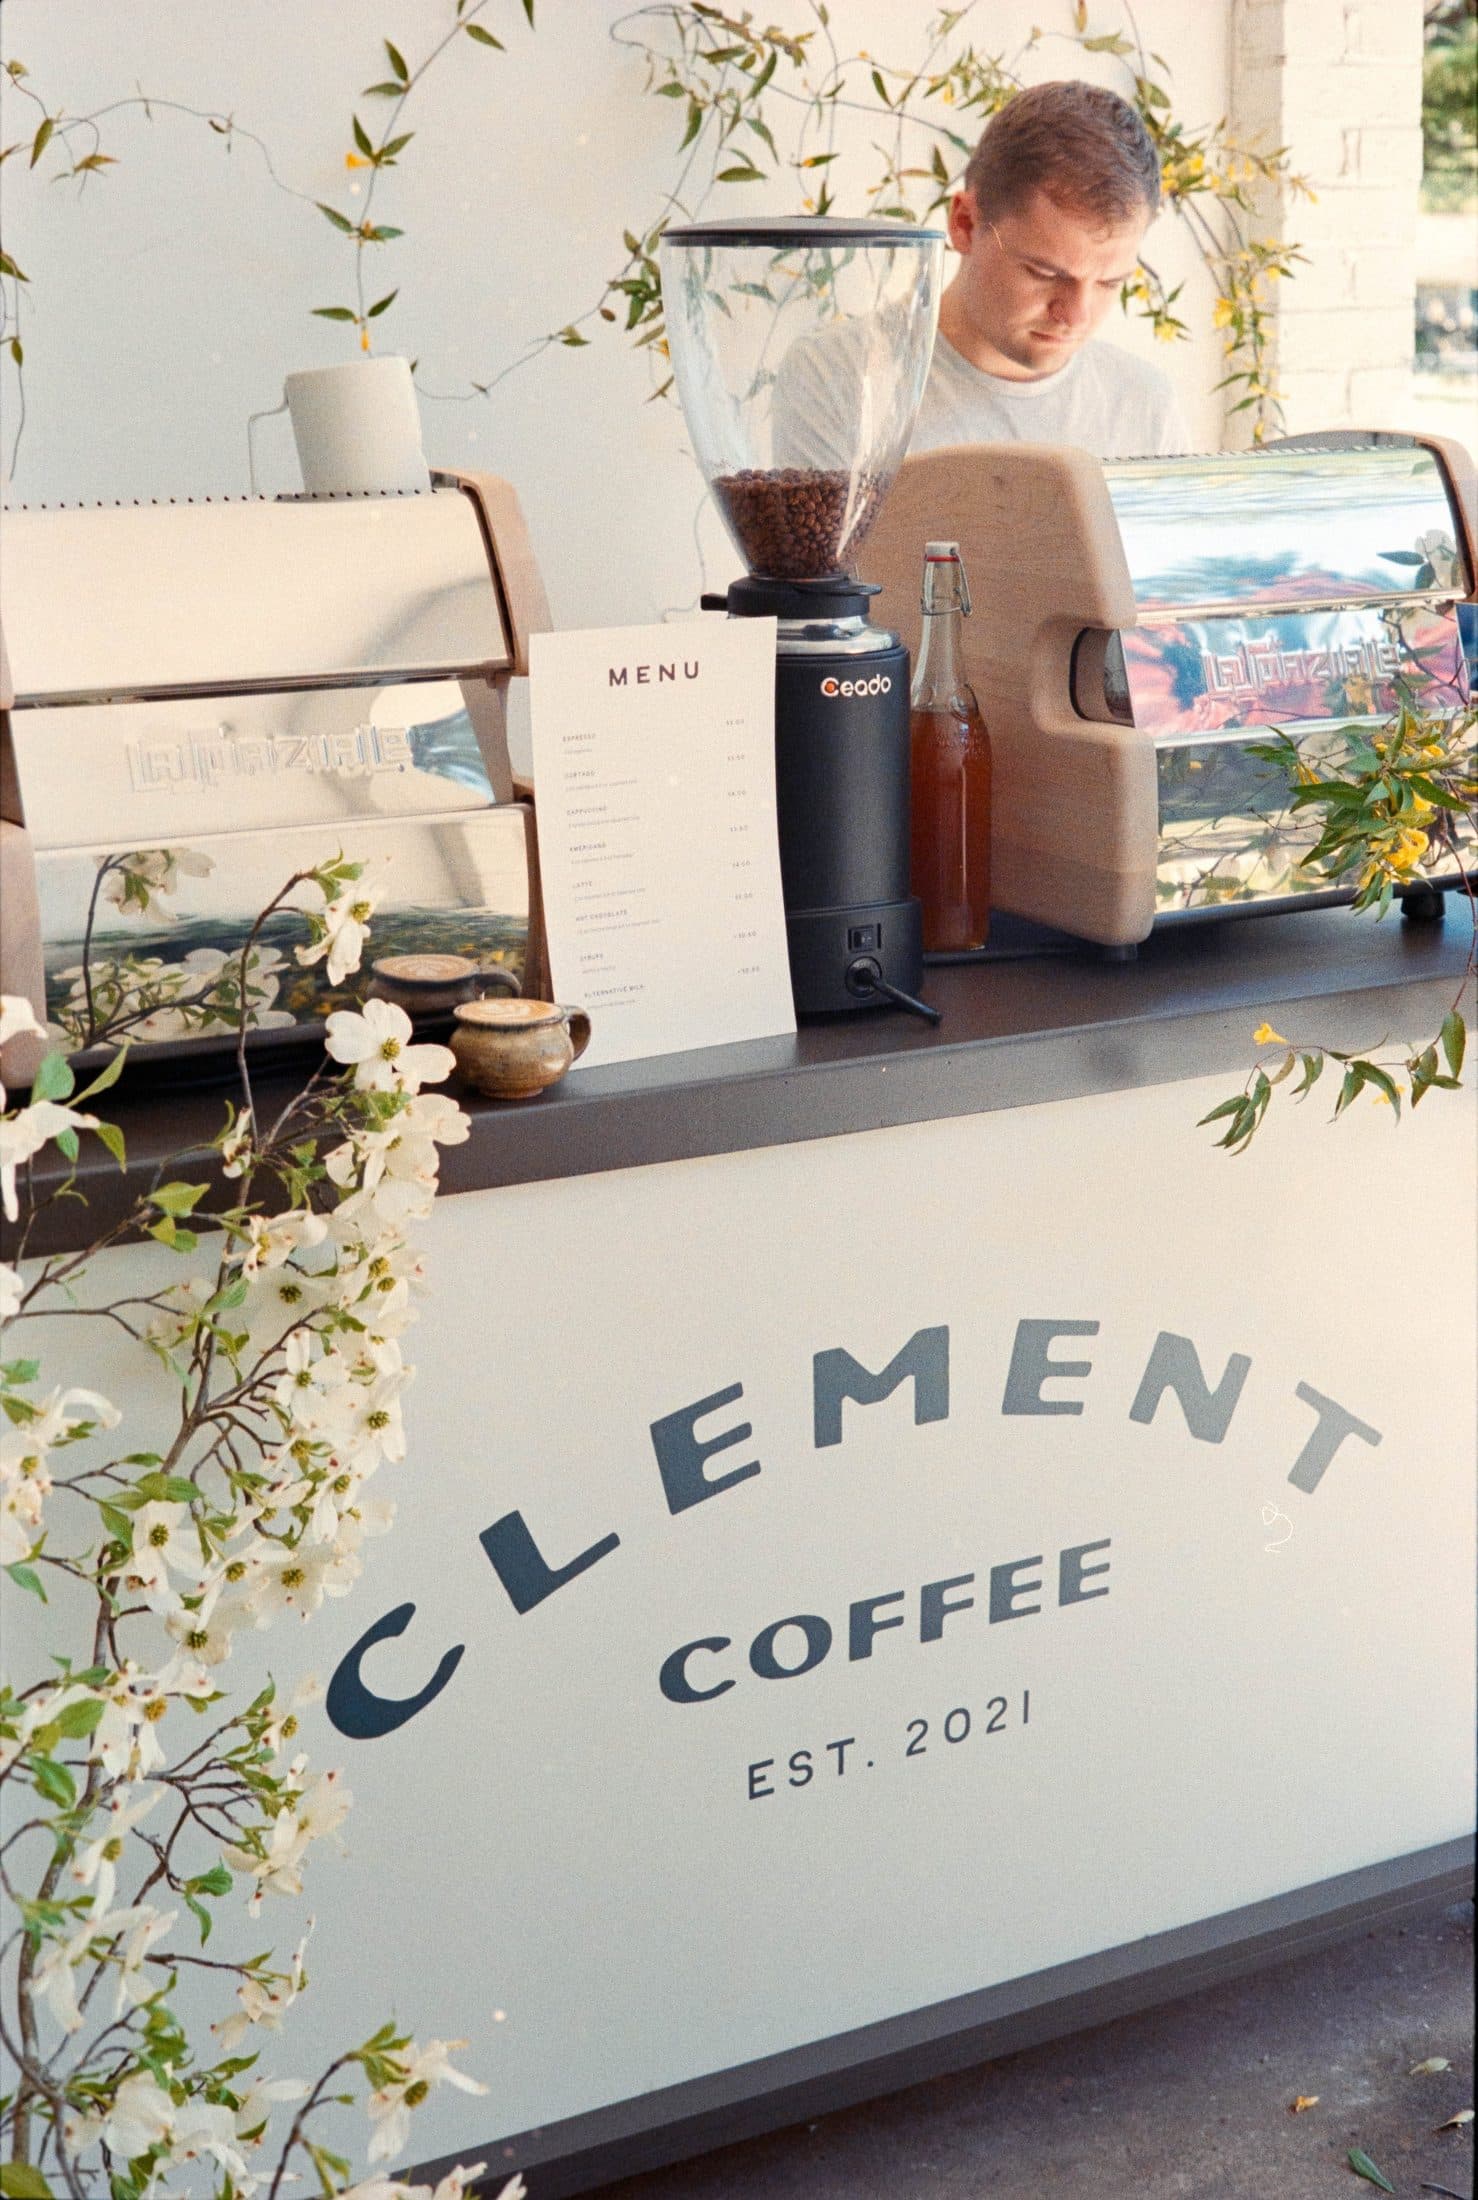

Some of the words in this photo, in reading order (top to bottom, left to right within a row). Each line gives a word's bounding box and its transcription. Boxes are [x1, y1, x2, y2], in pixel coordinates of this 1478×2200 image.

[608, 661, 699, 687] MENU
[820, 673, 892, 697] Ceado
[326, 1318, 1382, 1740] CLEMENT
[658, 1538, 1112, 1705] COFFEE
[748, 1738, 876, 1800] EST.
[905, 1690, 1031, 1758] 2021
